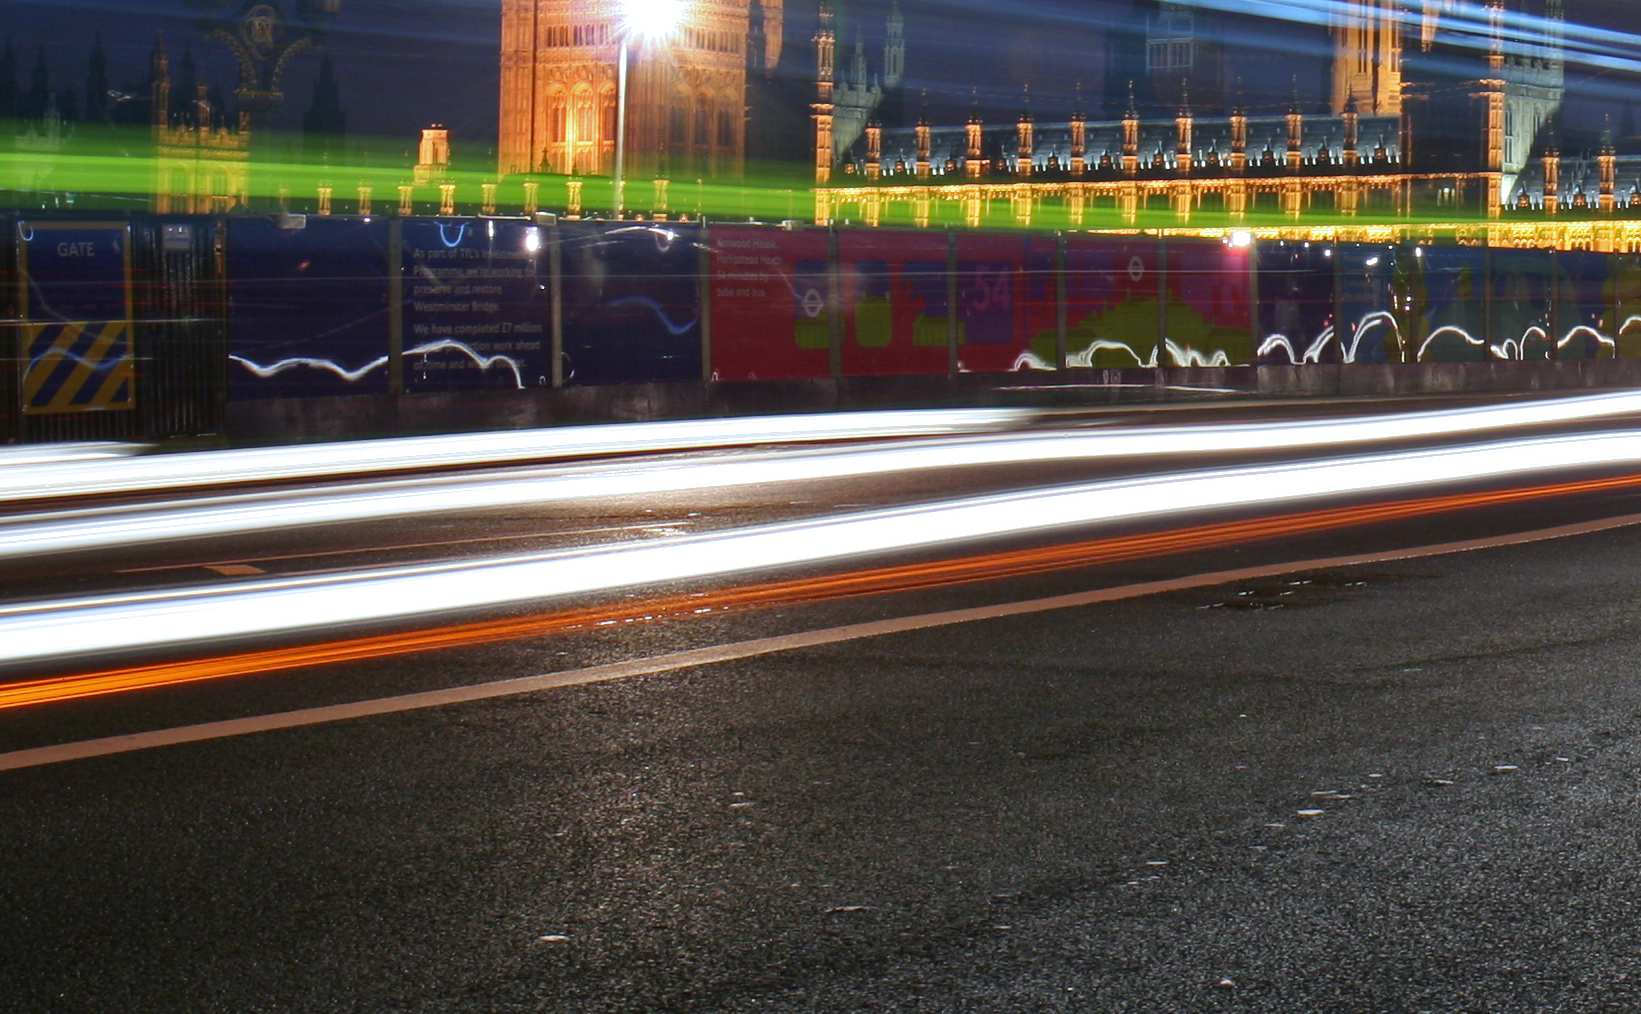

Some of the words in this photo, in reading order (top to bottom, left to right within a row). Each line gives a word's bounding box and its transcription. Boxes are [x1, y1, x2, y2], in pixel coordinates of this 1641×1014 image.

[57, 242, 95, 256] GATE
[413, 248, 425, 259] As
[427, 249, 447, 261] part
[449, 248, 458, 259] of
[454, 284, 470, 294] and
[472, 284, 502, 294] restore
[736, 288, 750, 298] and
[751, 288, 765, 298] bus
[973, 265, 1011, 311] 54
[413, 301, 470, 312] Westminster
[414, 323, 430, 335] We
[431, 323, 452, 334] have
[454, 322, 500, 336] completed
[514, 322, 542, 334] million
[493, 341, 514, 352] work
[515, 340, 541, 352] ahead
